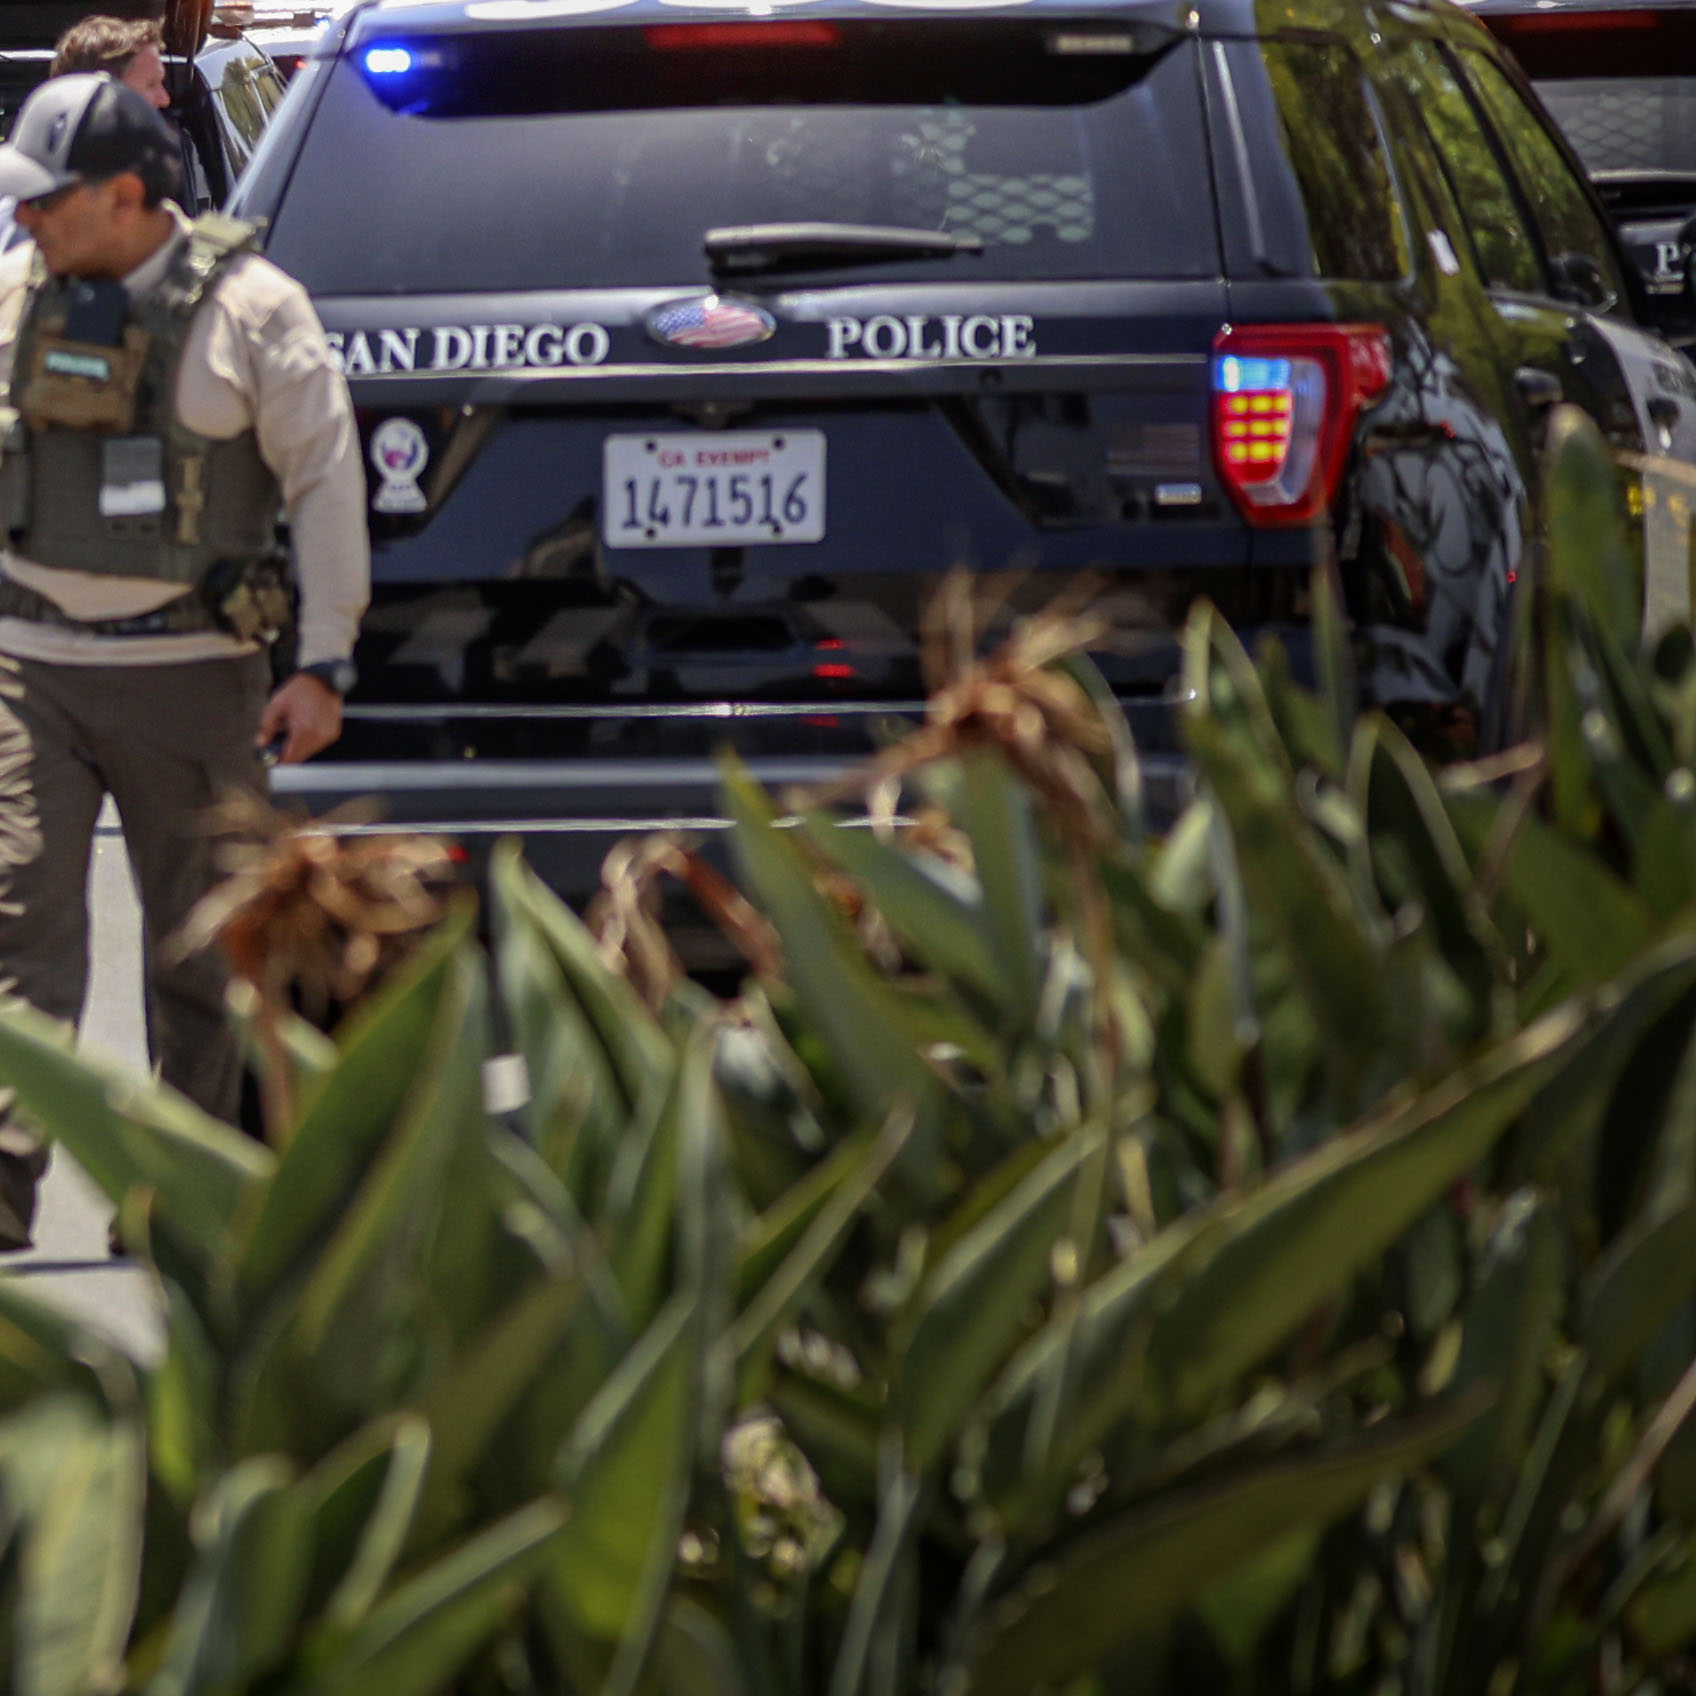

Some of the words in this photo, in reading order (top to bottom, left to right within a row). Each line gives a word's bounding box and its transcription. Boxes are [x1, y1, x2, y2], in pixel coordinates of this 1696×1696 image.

[324, 327, 421, 375] SAN
[432, 322, 610, 370] DIEGO
[825, 314, 1037, 359] POLICE
[695, 449, 770, 468] EXEMPT
[621, 472, 808, 530] 1471516
